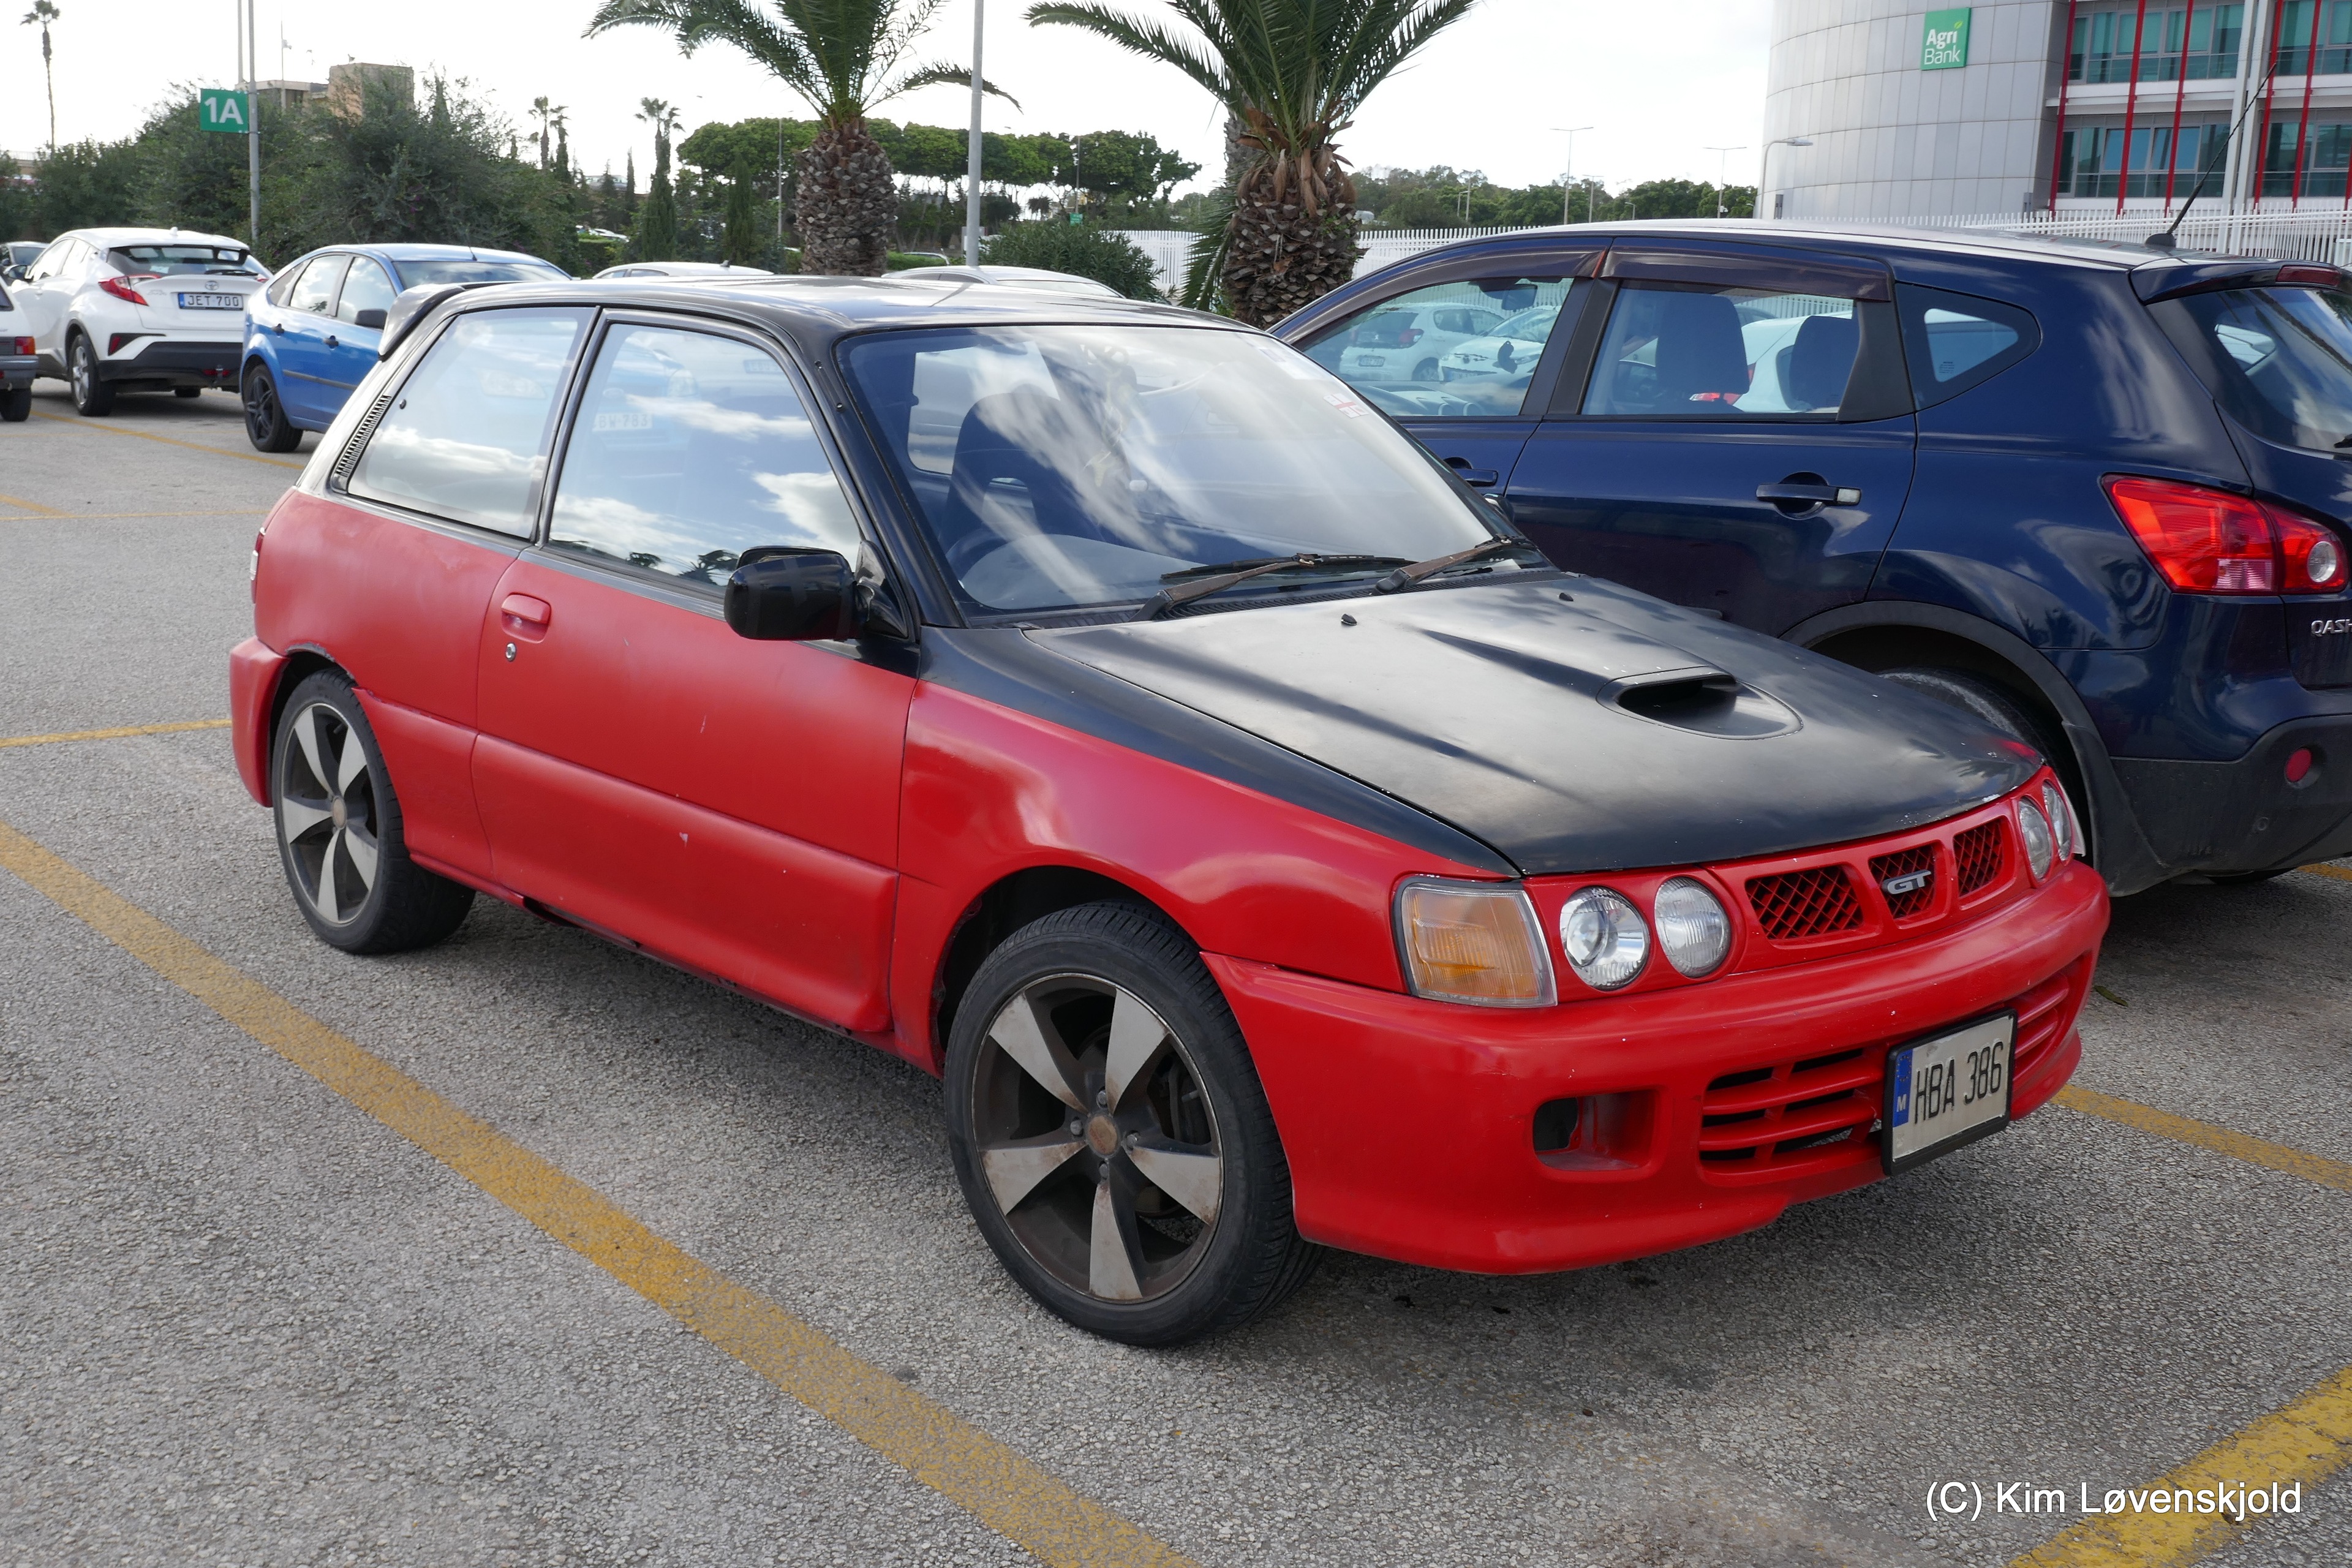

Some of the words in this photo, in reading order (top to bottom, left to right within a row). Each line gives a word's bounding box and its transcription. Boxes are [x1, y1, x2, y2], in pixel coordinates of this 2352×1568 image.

[1926, 28, 1958, 50] Agri
[1924, 45, 1961, 65] Bank
[204, 97, 244, 125] 1A
[187, 295, 211, 306] JET
[216, 296, 239, 306] 700
[1885, 870, 1931, 894] GT
[1915, 1058, 1956, 1124] HBA
[1964, 1041, 2004, 1104] 386
[1896, 1093, 1907, 1112] M
